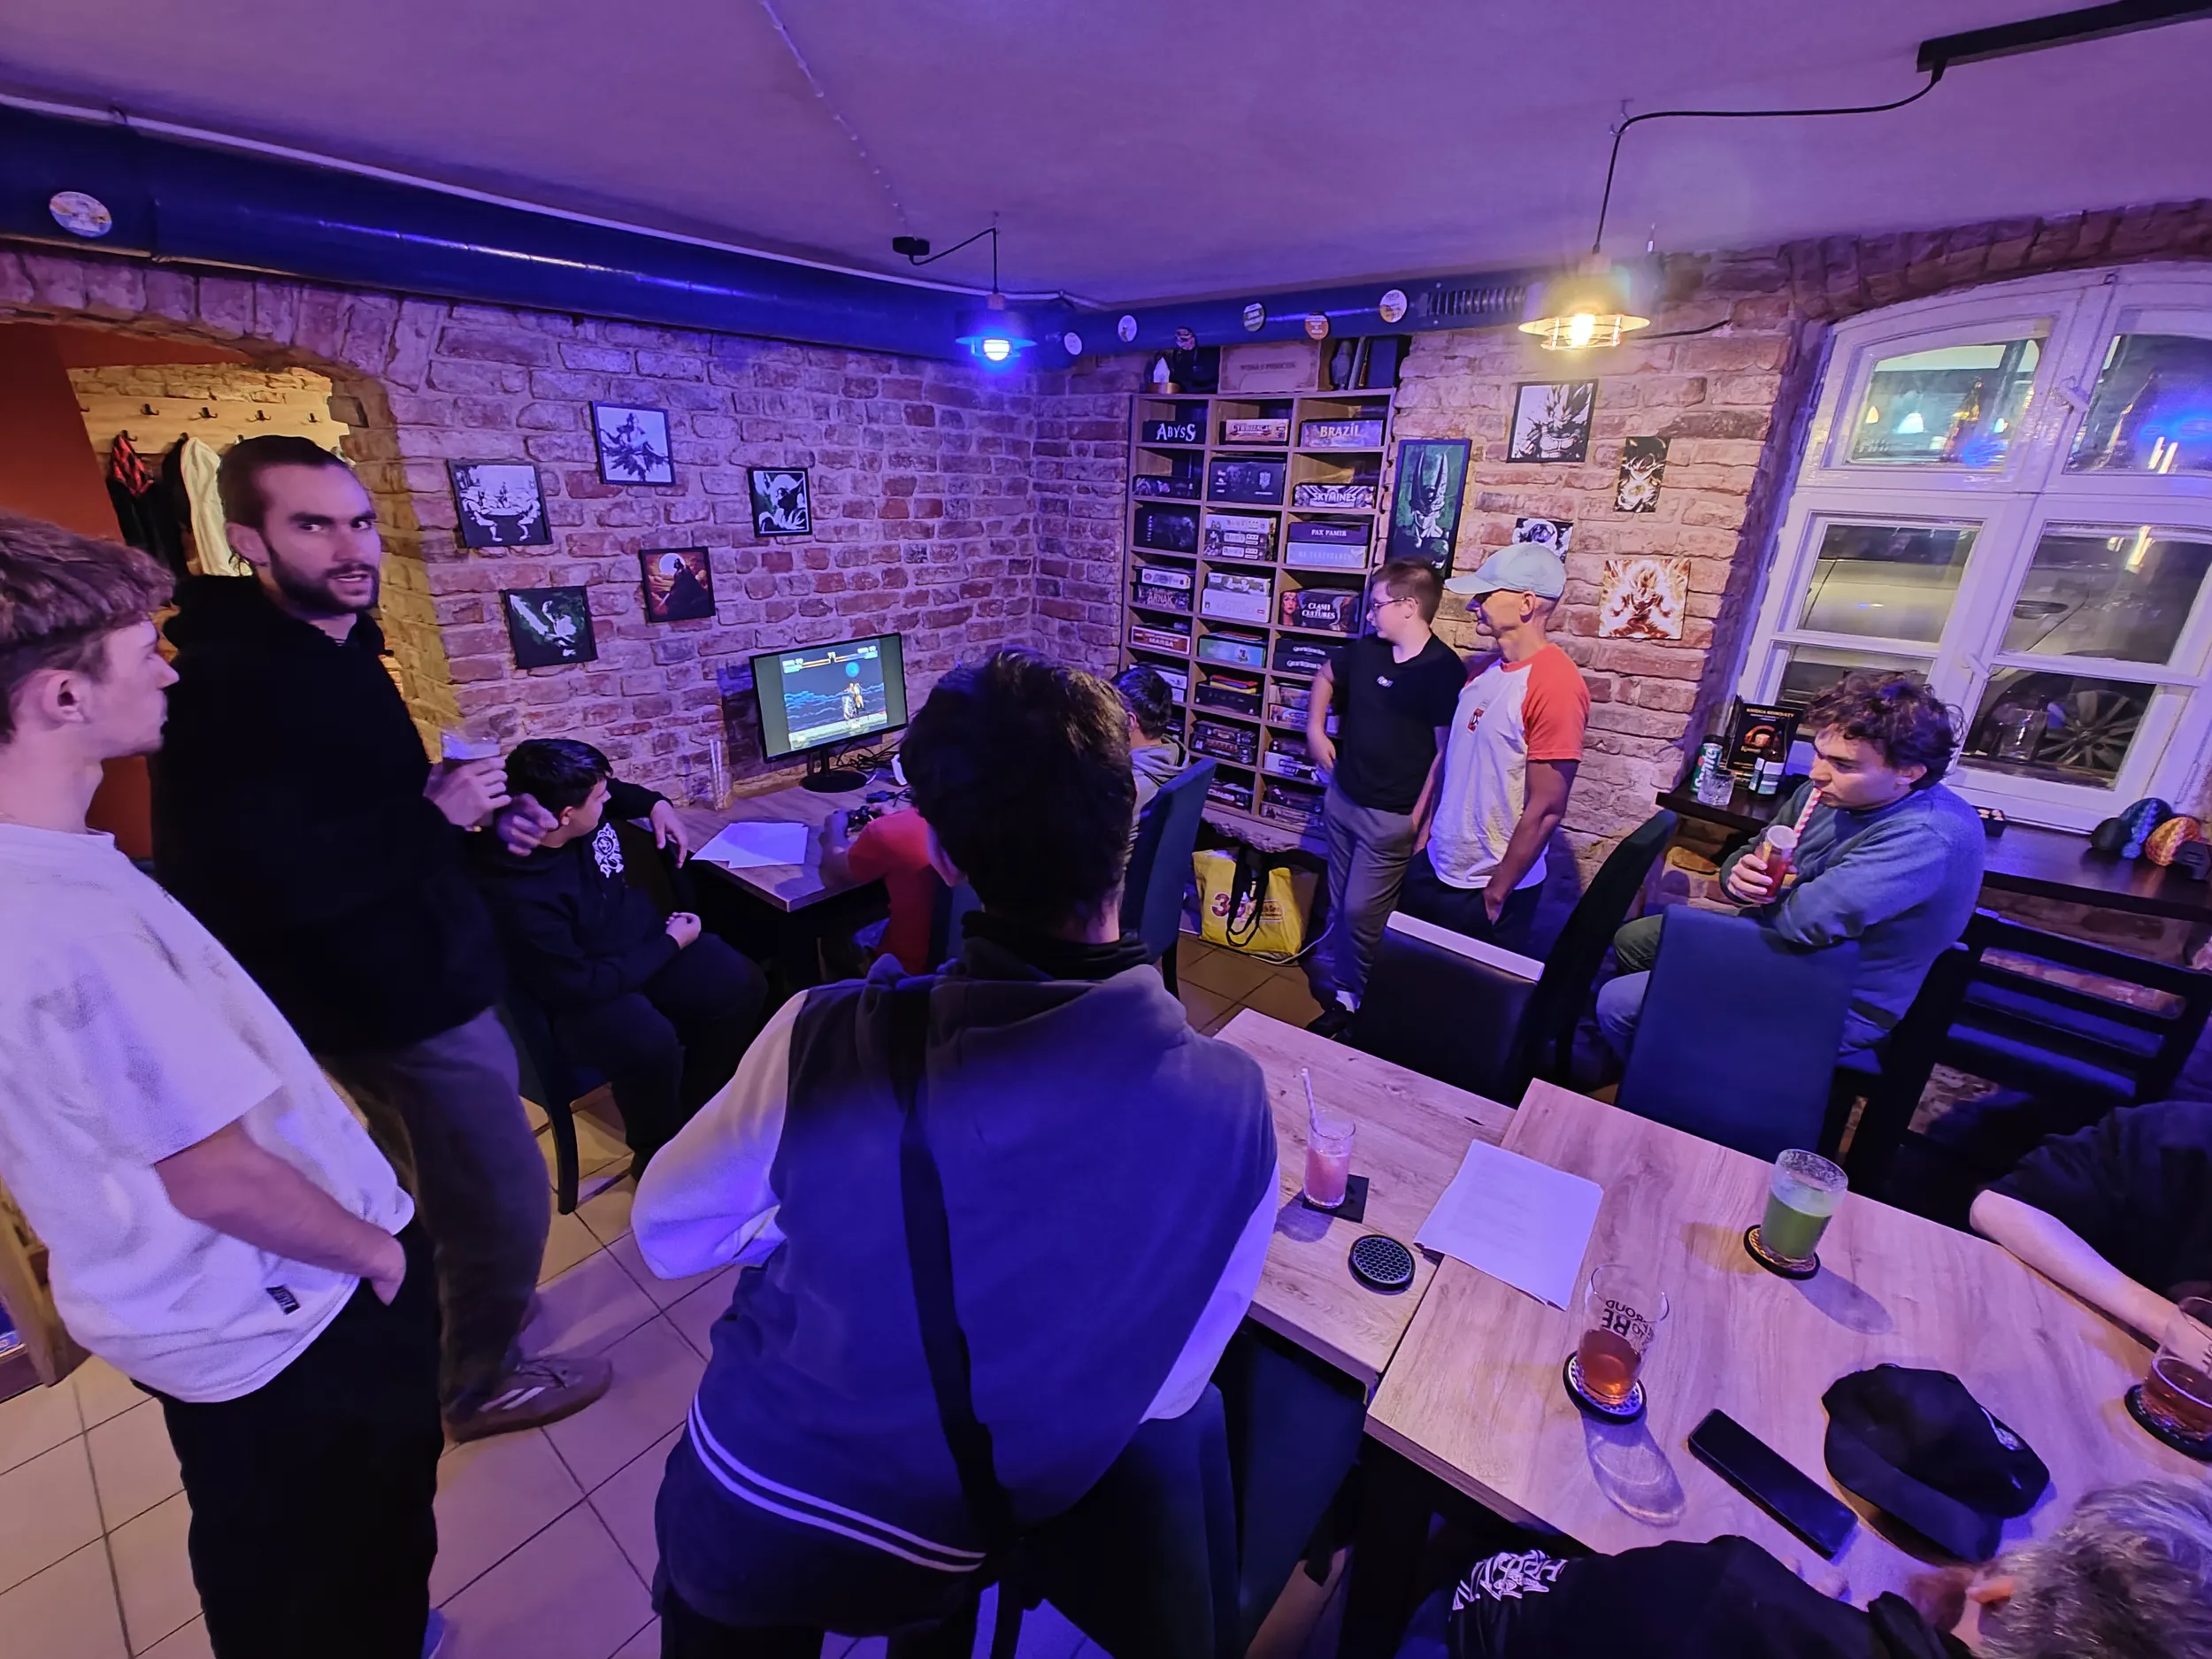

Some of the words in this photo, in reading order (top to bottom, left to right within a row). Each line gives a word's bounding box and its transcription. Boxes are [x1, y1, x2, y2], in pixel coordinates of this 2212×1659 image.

[1156, 423, 1196, 442] ABYSS
[1319, 423, 1360, 438] BRAZIL
[1312, 492, 1356, 503] SKYMINES
